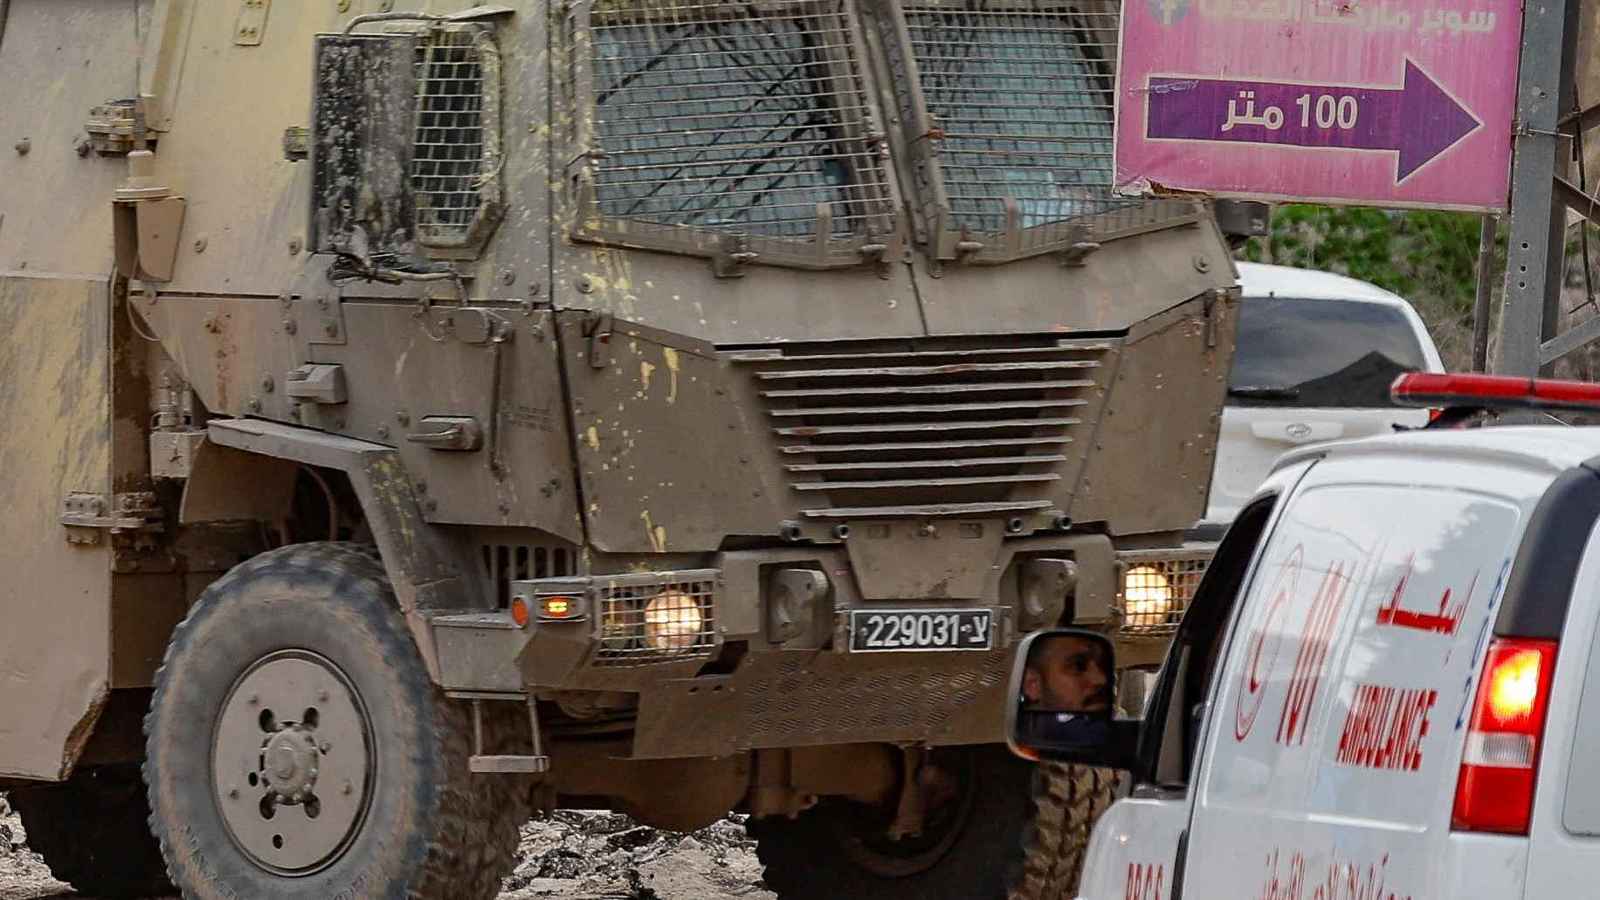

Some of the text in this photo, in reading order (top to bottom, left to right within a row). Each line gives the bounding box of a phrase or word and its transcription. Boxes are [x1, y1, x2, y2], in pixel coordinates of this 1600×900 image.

[1221, 91, 1358, 132] 100 متر
[1335, 684, 1438, 771] AMBULANCE
